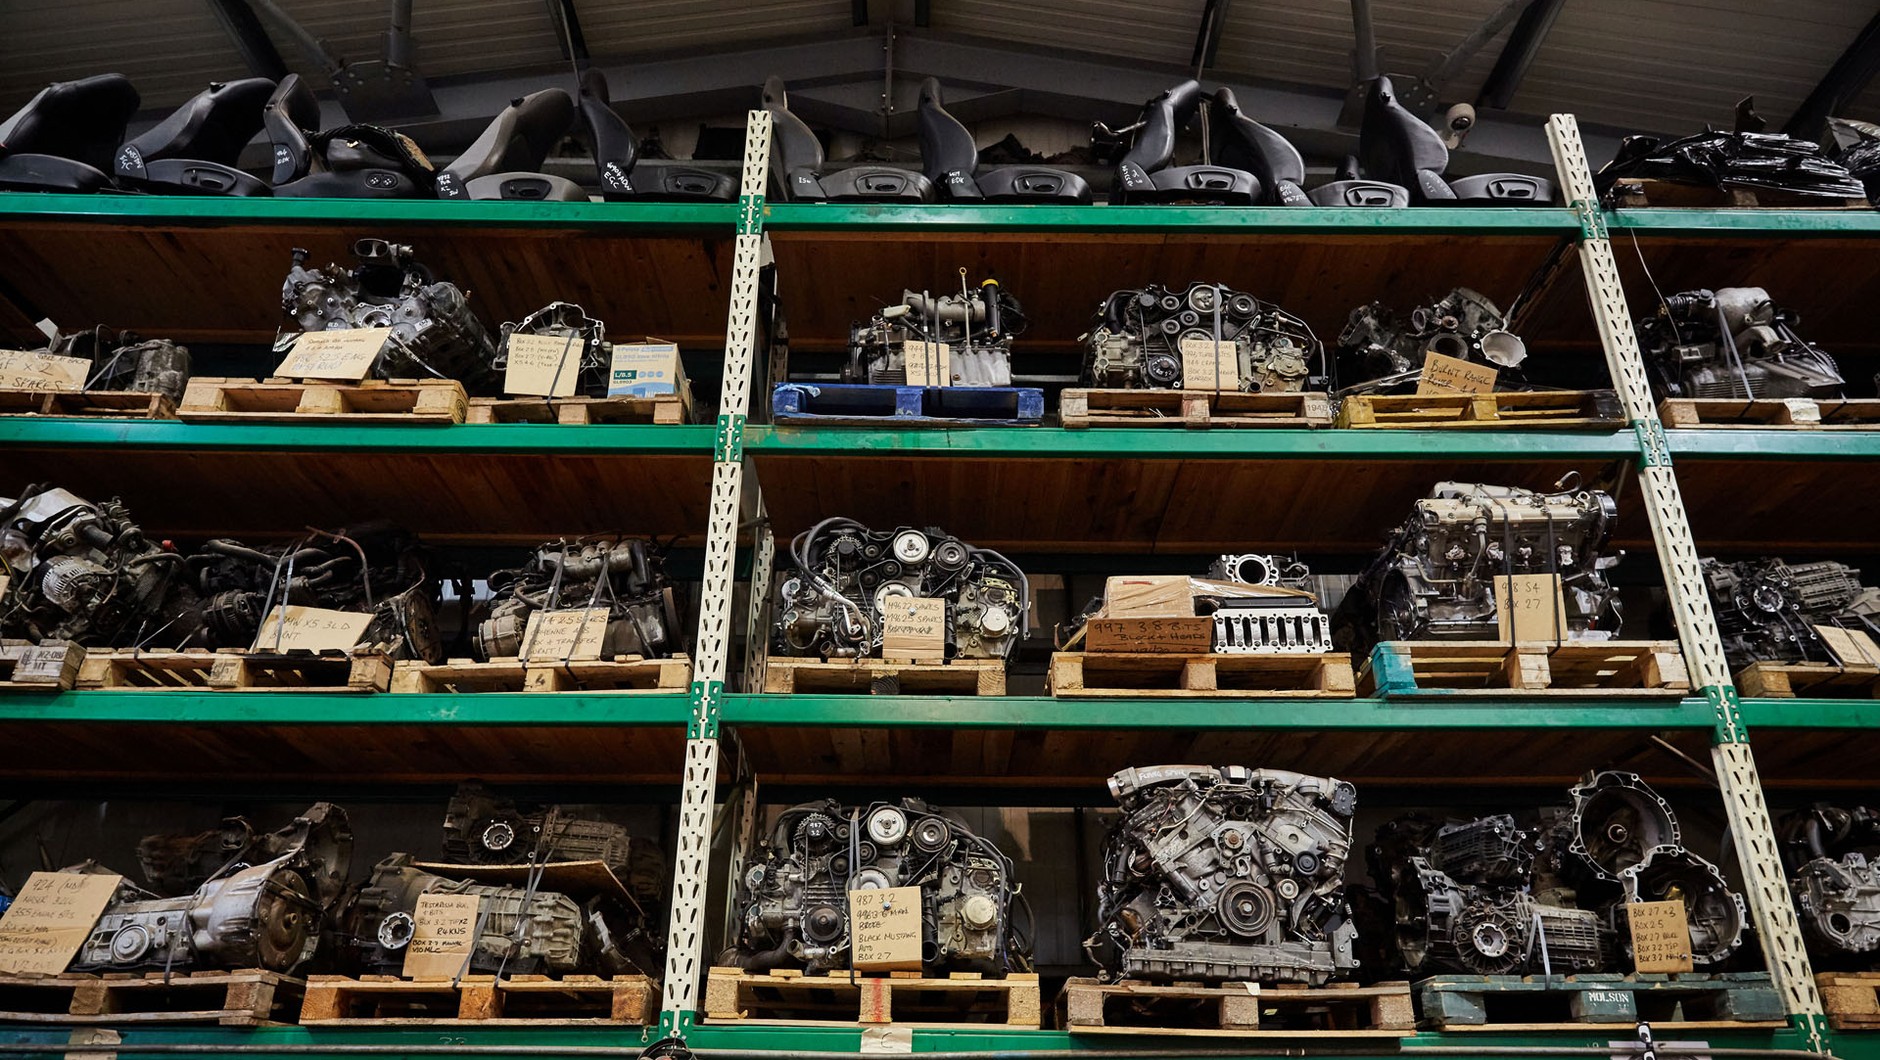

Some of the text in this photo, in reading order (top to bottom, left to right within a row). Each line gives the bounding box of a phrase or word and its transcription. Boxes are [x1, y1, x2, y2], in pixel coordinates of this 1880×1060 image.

[1464, 370, 1491, 385] RANGE
[1501, 581, 1519, 593] 98
[1094, 622, 1125, 634] 997
[856, 894, 874, 906] 987
[1632, 907, 1645, 918] BOX
[1634, 920, 1649, 930] BOX
[858, 931, 917, 944] BLACK MUSTANG
[1636, 932, 1648, 943] BOX
[1637, 943, 1650, 954] BOX
[857, 953, 874, 961] BOX
[1639, 954, 1651, 963] BOX
[1588, 991, 1630, 1003] MOLSON
